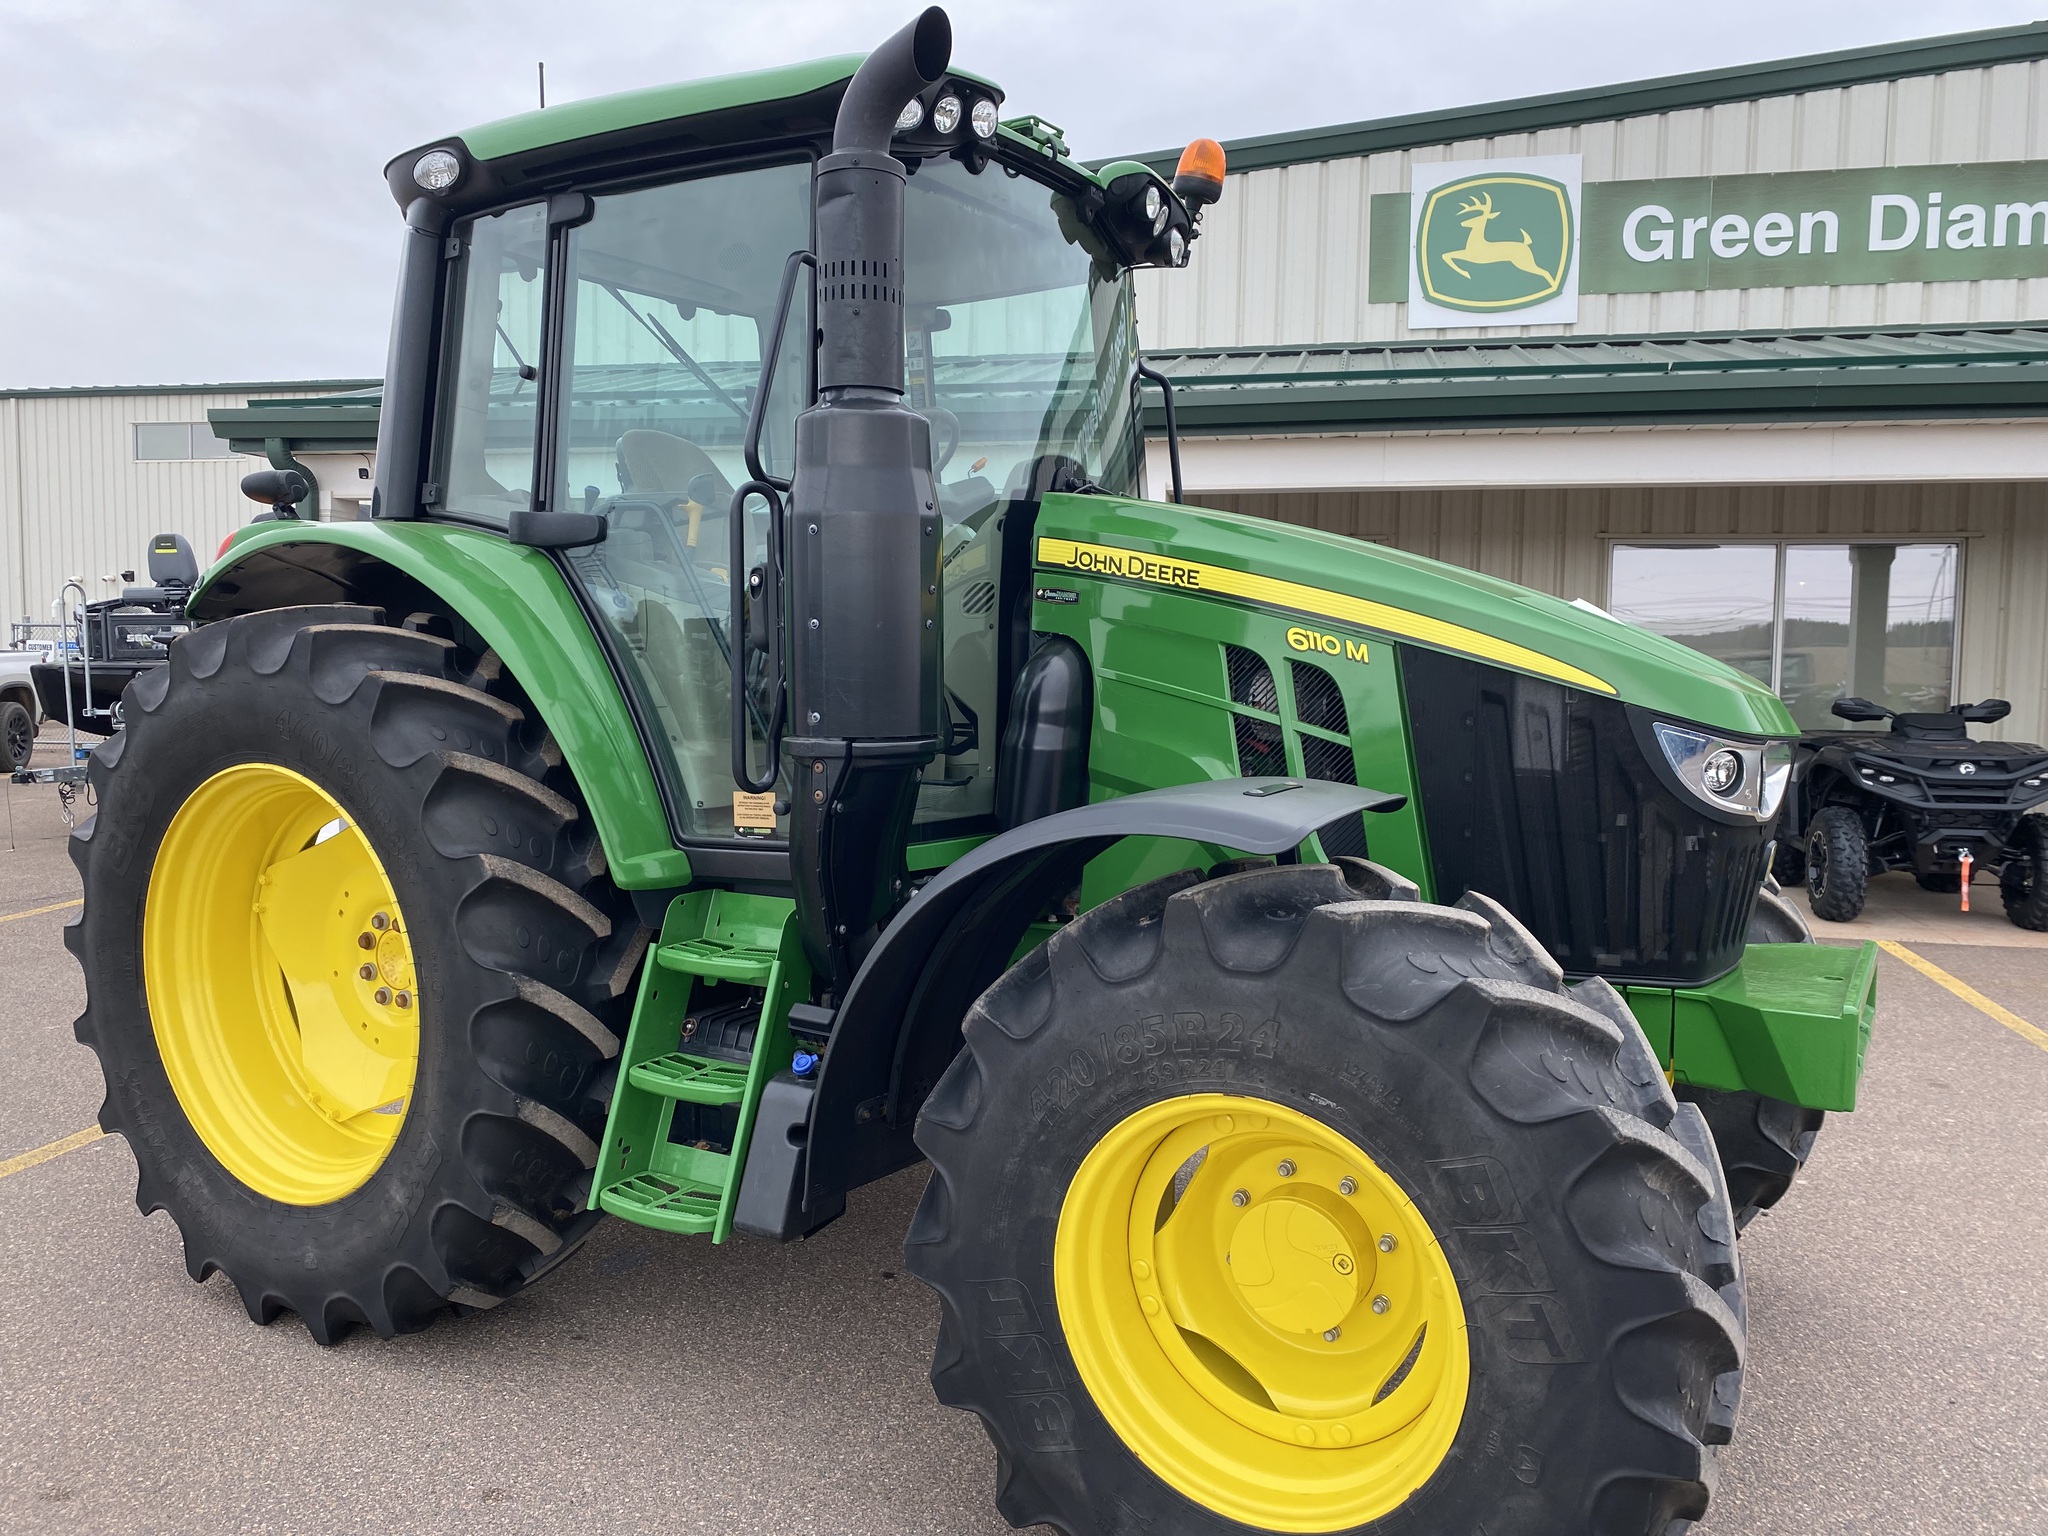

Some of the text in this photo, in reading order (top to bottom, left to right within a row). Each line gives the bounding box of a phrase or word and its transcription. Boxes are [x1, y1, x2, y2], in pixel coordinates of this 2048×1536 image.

[1623, 192, 2048, 262] Green Diam
[1066, 547, 1200, 587] JOHN DEERE
[28, 643, 53, 651] CUSTOMER
[1287, 626, 1369, 664] 6110 M
[1430, 1160, 1582, 1361] BKT
